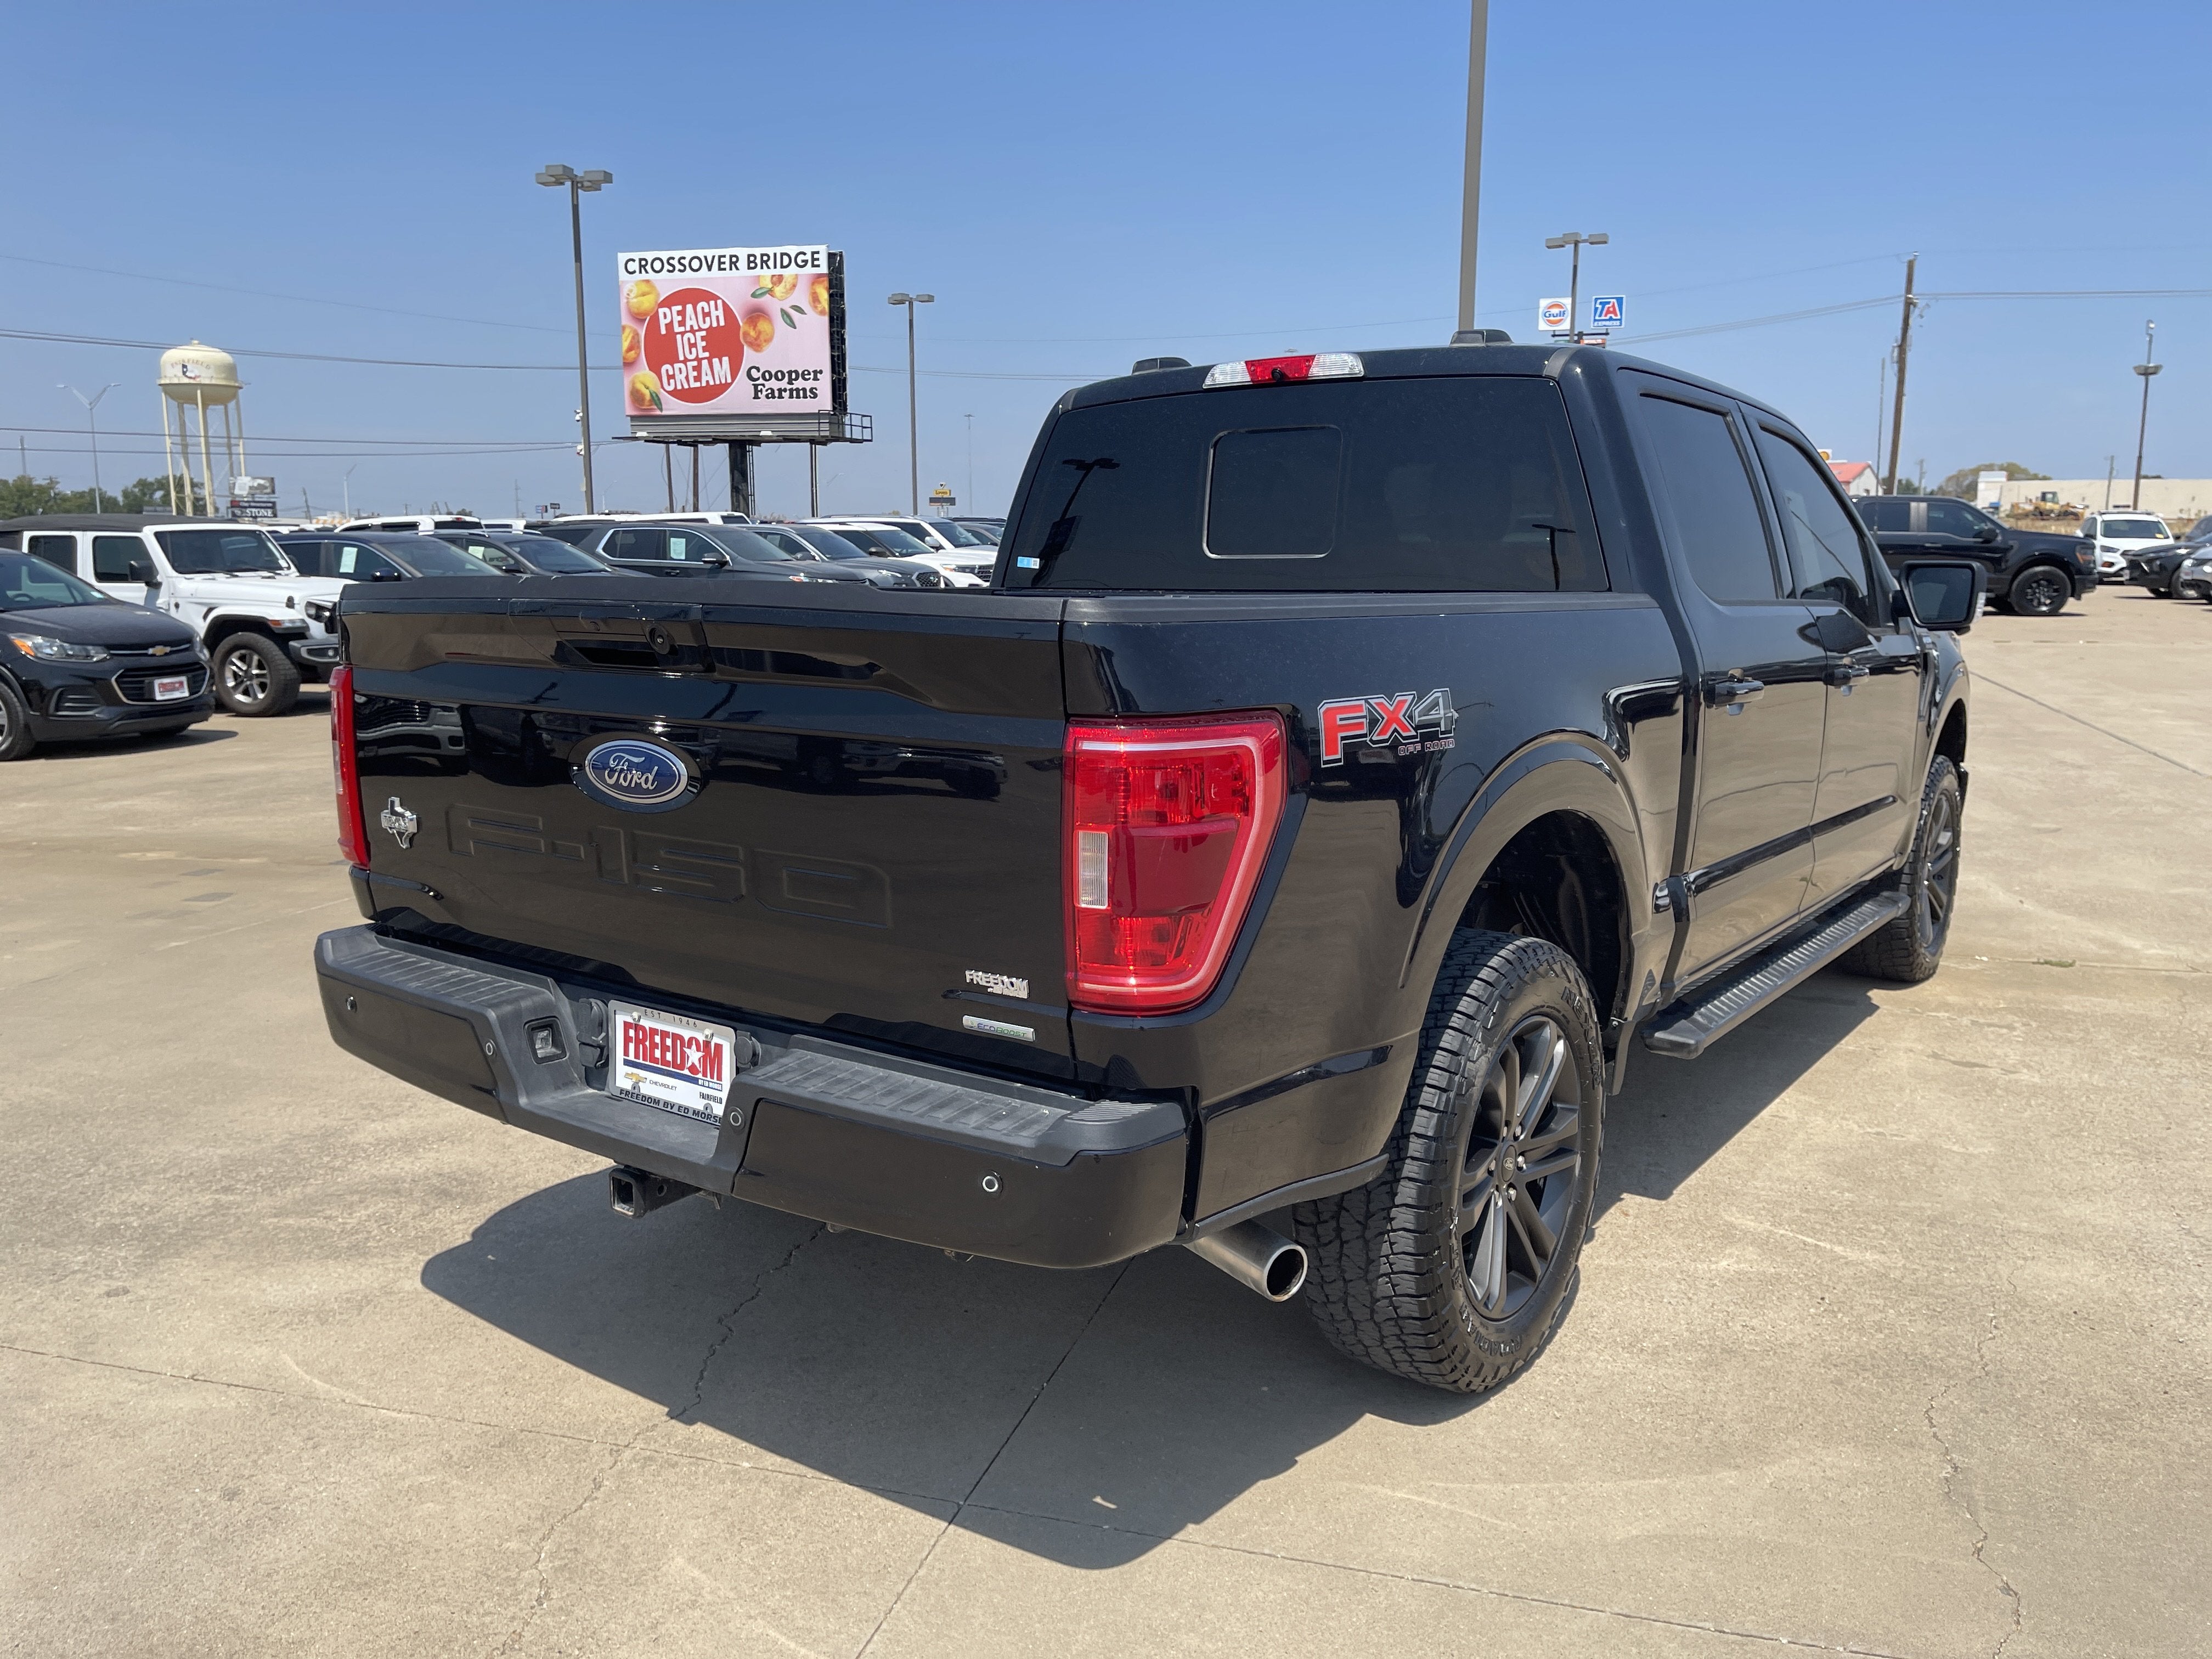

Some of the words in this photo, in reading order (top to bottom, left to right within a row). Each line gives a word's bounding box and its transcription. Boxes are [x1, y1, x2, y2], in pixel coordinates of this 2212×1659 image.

[624, 254, 740, 275] CROSSOVER
[746, 250, 821, 270] BRIDGE
[658, 299, 725, 335] PEACH
[1544, 310, 1566, 318] Gulf
[1595, 298, 1621, 319] TA
[676, 331, 709, 361] ICE
[661, 357, 732, 392] CREAM
[746, 365, 823, 385] Cooper
[752, 383, 819, 400] Farms
[1318, 688, 1455, 768] FX4
[1398, 743, 1421, 755] OFF
[1425, 738, 1455, 752] ROAD
[605, 752, 658, 790] Ford
[447, 803, 892, 929] F-150
[965, 969, 1029, 994] FREEDOM
[673, 1016, 697, 1028] 1946
[978, 1023, 1027, 1037] ECOBOOST
[623, 1020, 723, 1081] FREEDOM
[649, 1080, 677, 1091] CHEVROLET
[699, 1091, 723, 1104] FAIRFIELD
[619, 1089, 660, 1107] FREEDOM
[663, 1102, 675, 1110] BY
[678, 1105, 690, 1115] ED
